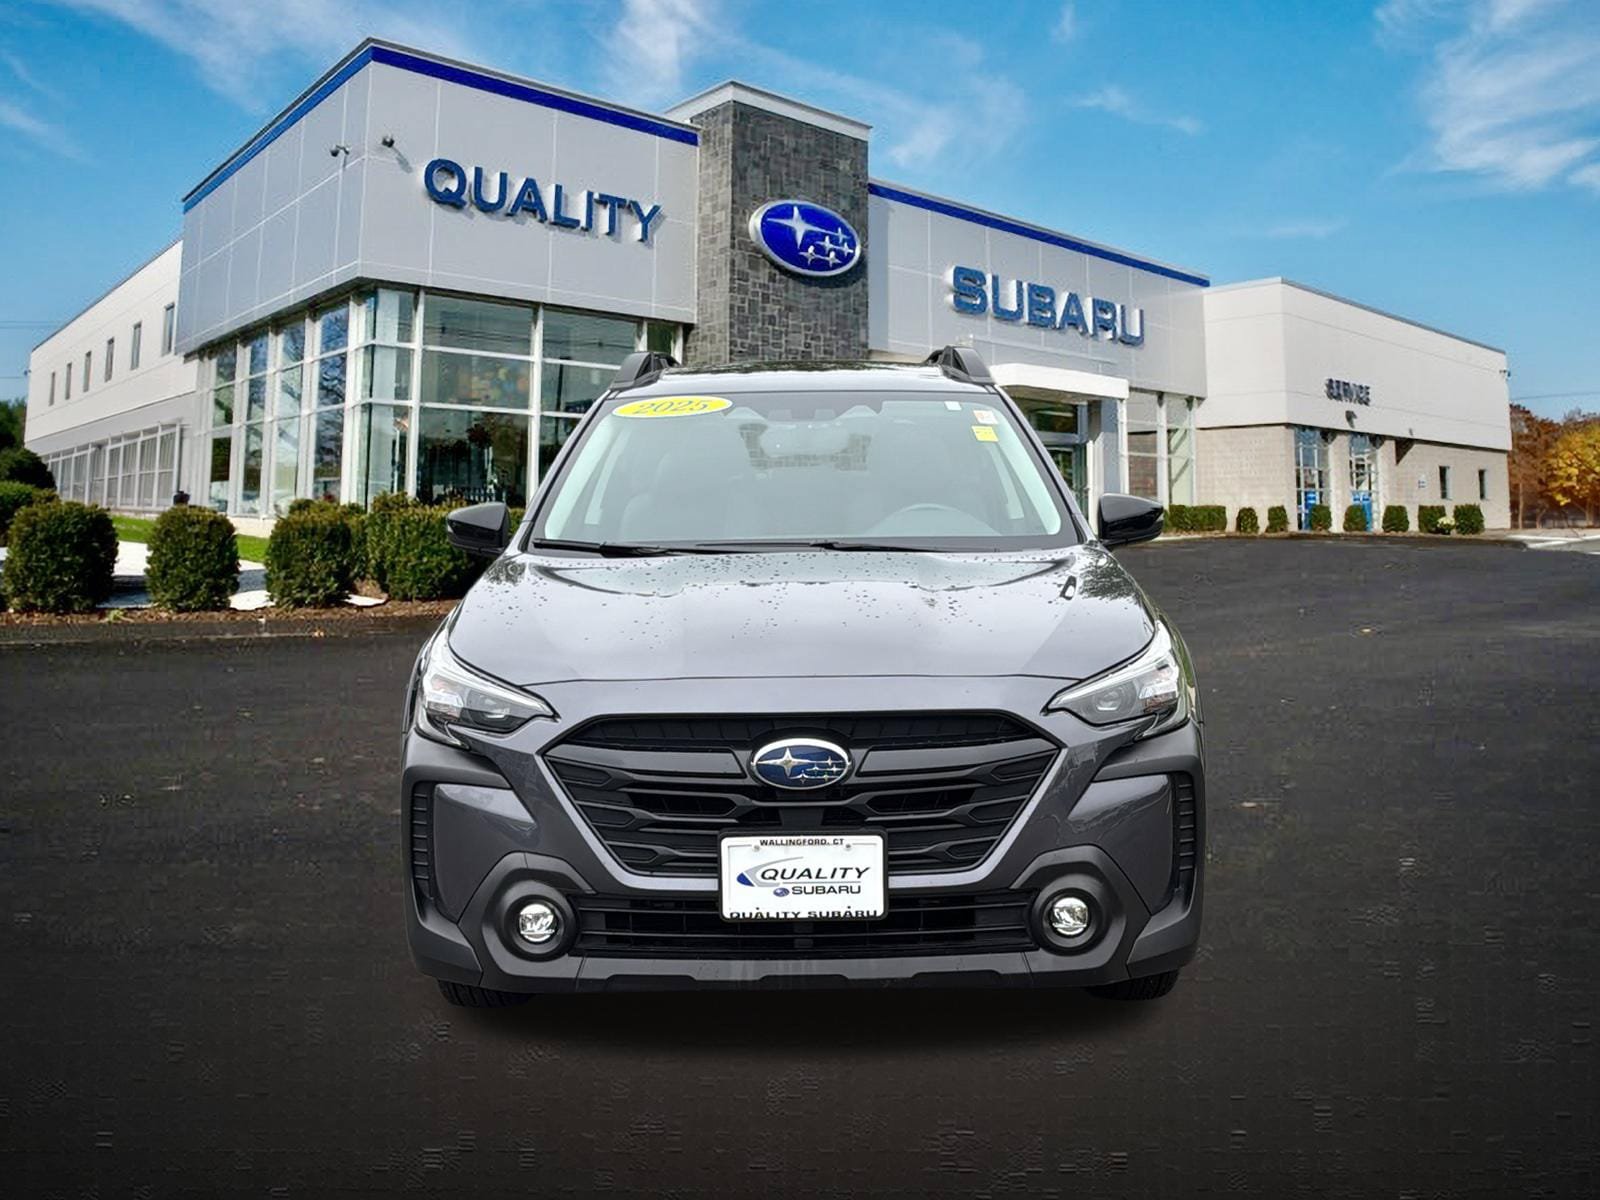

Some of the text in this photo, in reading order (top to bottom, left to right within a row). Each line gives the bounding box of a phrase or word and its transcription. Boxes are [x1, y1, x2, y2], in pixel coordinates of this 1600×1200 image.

[424, 158, 661, 242] QUALITY
[949, 266, 1144, 346] SUBARU
[632, 400, 709, 414] 2025
[832, 838, 845, 846] CT
[760, 867, 870, 881] QUALITY
[791, 886, 861, 895] SUBARU
